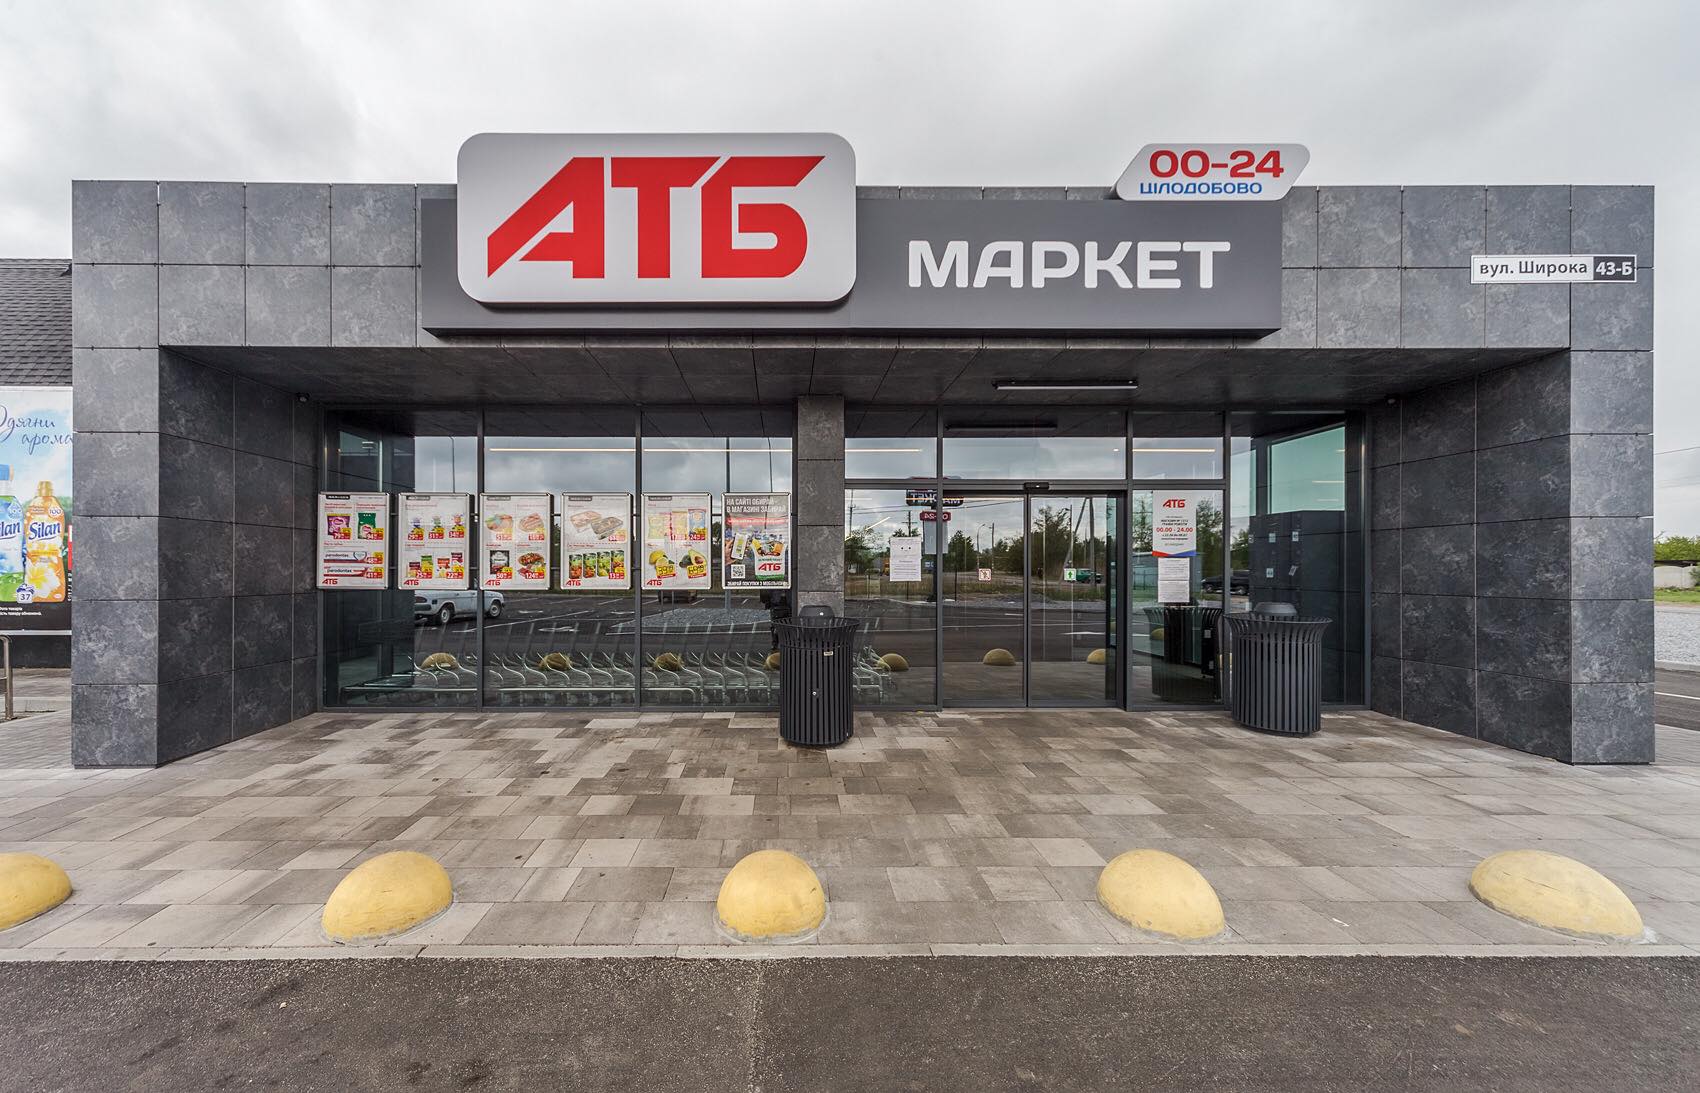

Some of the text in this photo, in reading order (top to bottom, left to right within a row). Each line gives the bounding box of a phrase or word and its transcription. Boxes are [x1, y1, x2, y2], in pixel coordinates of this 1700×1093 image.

[1149, 150, 1284, 178] 00-24
[1140, 182, 1263, 196] ЦІЛОДОБОВО
[488, 155, 826, 279] АТБ
[909, 240, 1231, 289] МАРКЕТ
[1480, 261, 1633, 278] вул. Широка 43-Б
[1163, 499, 1185, 508] АТБ
[0, 521, 20, 537] lan
[28, 522, 61, 540] Silan
[758, 563, 783, 571] АТБ
[20, 593, 31, 601] 37
